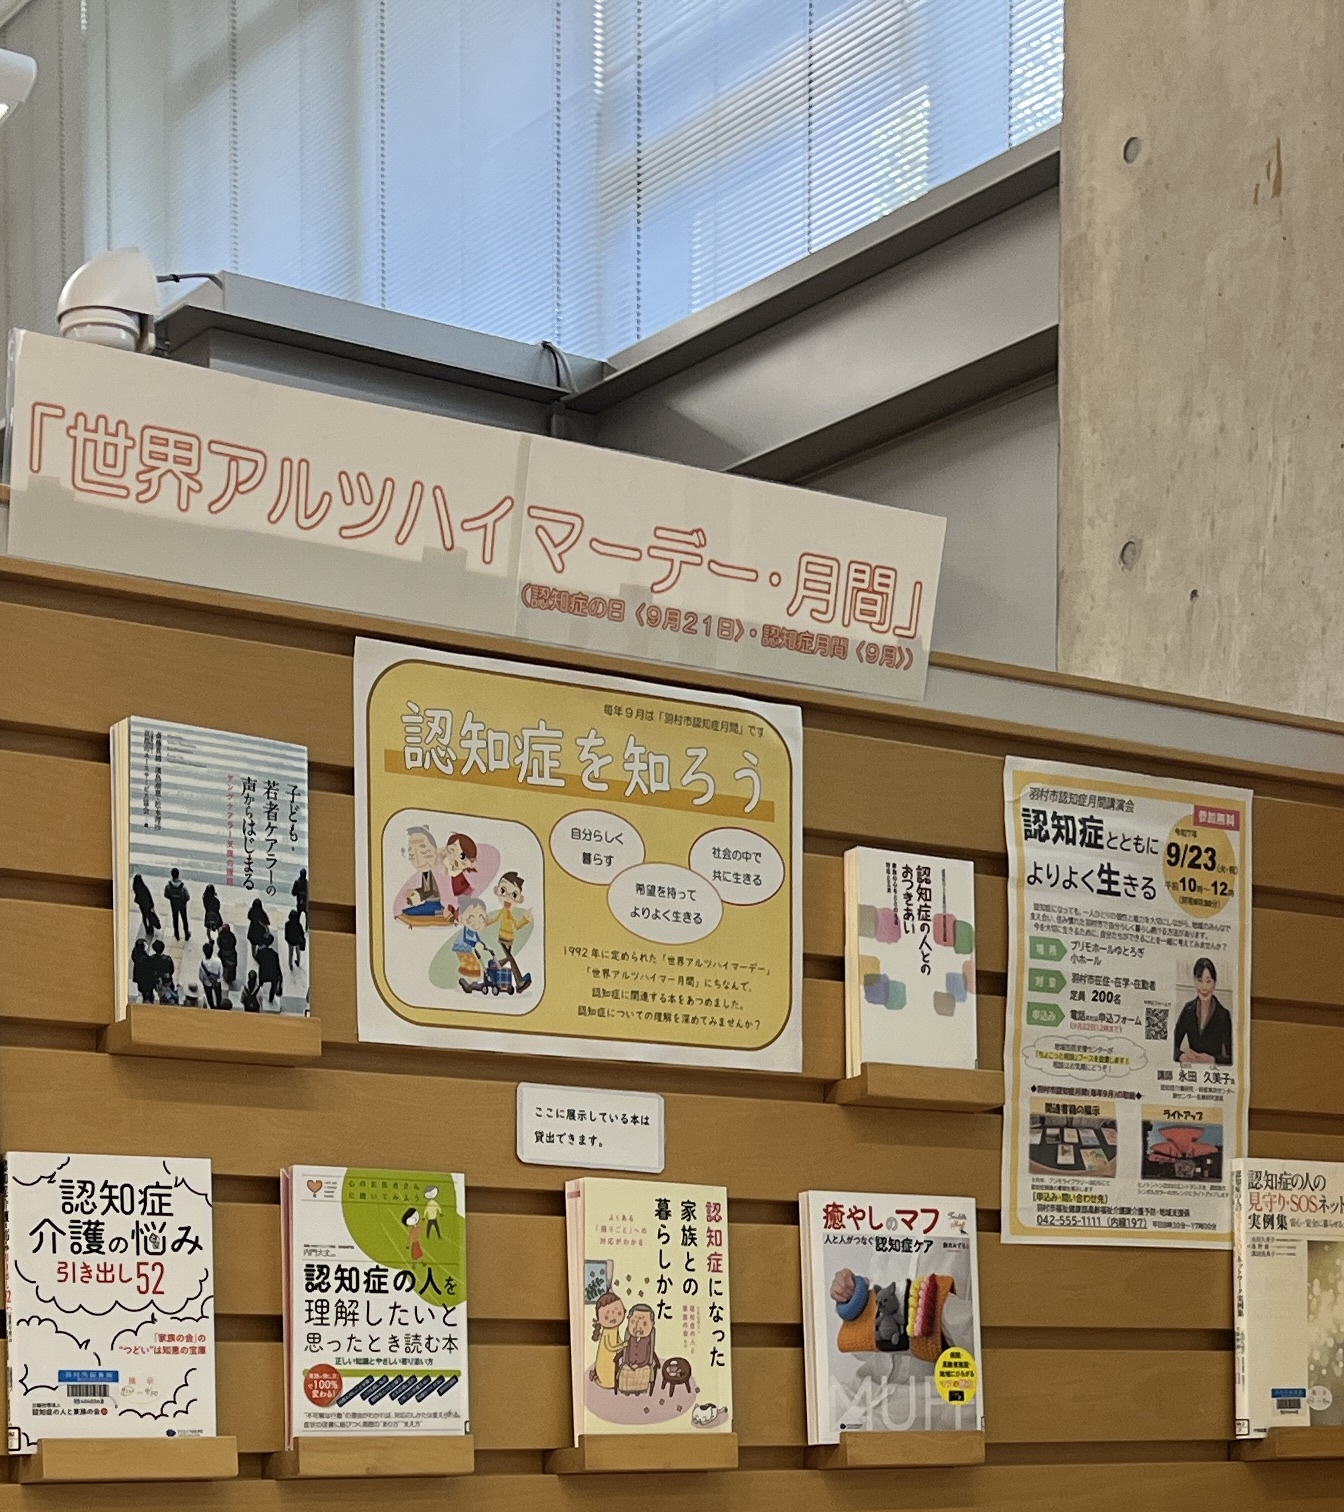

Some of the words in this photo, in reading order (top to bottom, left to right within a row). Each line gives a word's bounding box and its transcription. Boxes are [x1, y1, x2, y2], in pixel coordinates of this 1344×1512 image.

[30, 402, 924, 638] 「世界アルツハイマーデー・月間」
[401, 700, 763, 814] 認知症を知ろう
[241, 776, 257, 890] 声からはじまる
[264, 780, 279, 897] 若者ケアラーの
[571, 828, 623, 845] 自分らしく
[1022, 808, 1159, 854] 認知症とともに
[582, 852, 614, 867] 暮らす
[712, 847, 762, 864] 社会の中で
[713, 870, 763, 886] 共に生きる
[1027, 861, 1156, 899] よりよく生きる
[635, 883, 697, 902] 希望を持って
[902, 864, 915, 934] おつきあい
[630, 907, 703, 926] よりよく生きる
[916, 865, 932, 975] 認知症の人との
[1071, 940, 1144, 957] プリモホールゆとろぎ
[1071, 954, 1101, 965] 小ホール
[592, 988, 744, 1010] 認知症に関連する本をあつめました。
[1070, 990, 1085, 1002] 定員
[1092, 990, 1121, 1004] 200名
[578, 1006, 760, 1030] 認知症についての理解を深めてみませんか?
[1179, 1071, 1197, 1082] 永田
[535, 1106, 650, 1126] ここに展示している本は
[1163, 1110, 1203, 1120] ライトアップ
[534, 1131, 602, 1148] 貸出できます。
[1247, 1170, 1326, 1191] 認知症の人の
[60, 1179, 174, 1216] 認知症
[822, 1202, 940, 1234] 癒やしのマフ
[1037, 1214, 1101, 1226] 042-555-1111
[1248, 1213, 1288, 1231] 実例集
[30, 1218, 203, 1256] 介護の悩み
[681, 1200, 698, 1296] 家族との
[655, 1198, 673, 1321] 暮らしかた
[57, 1261, 165, 1294] 引き出し52
[305, 1264, 457, 1296] 認知症の人を
[706, 1202, 726, 1368] 認知症になった
[305, 1299, 457, 1328] 理解したいと
[154, 1333, 206, 1343] 「家族の会」の
[305, 1333, 459, 1354] 思ったとき読む本
